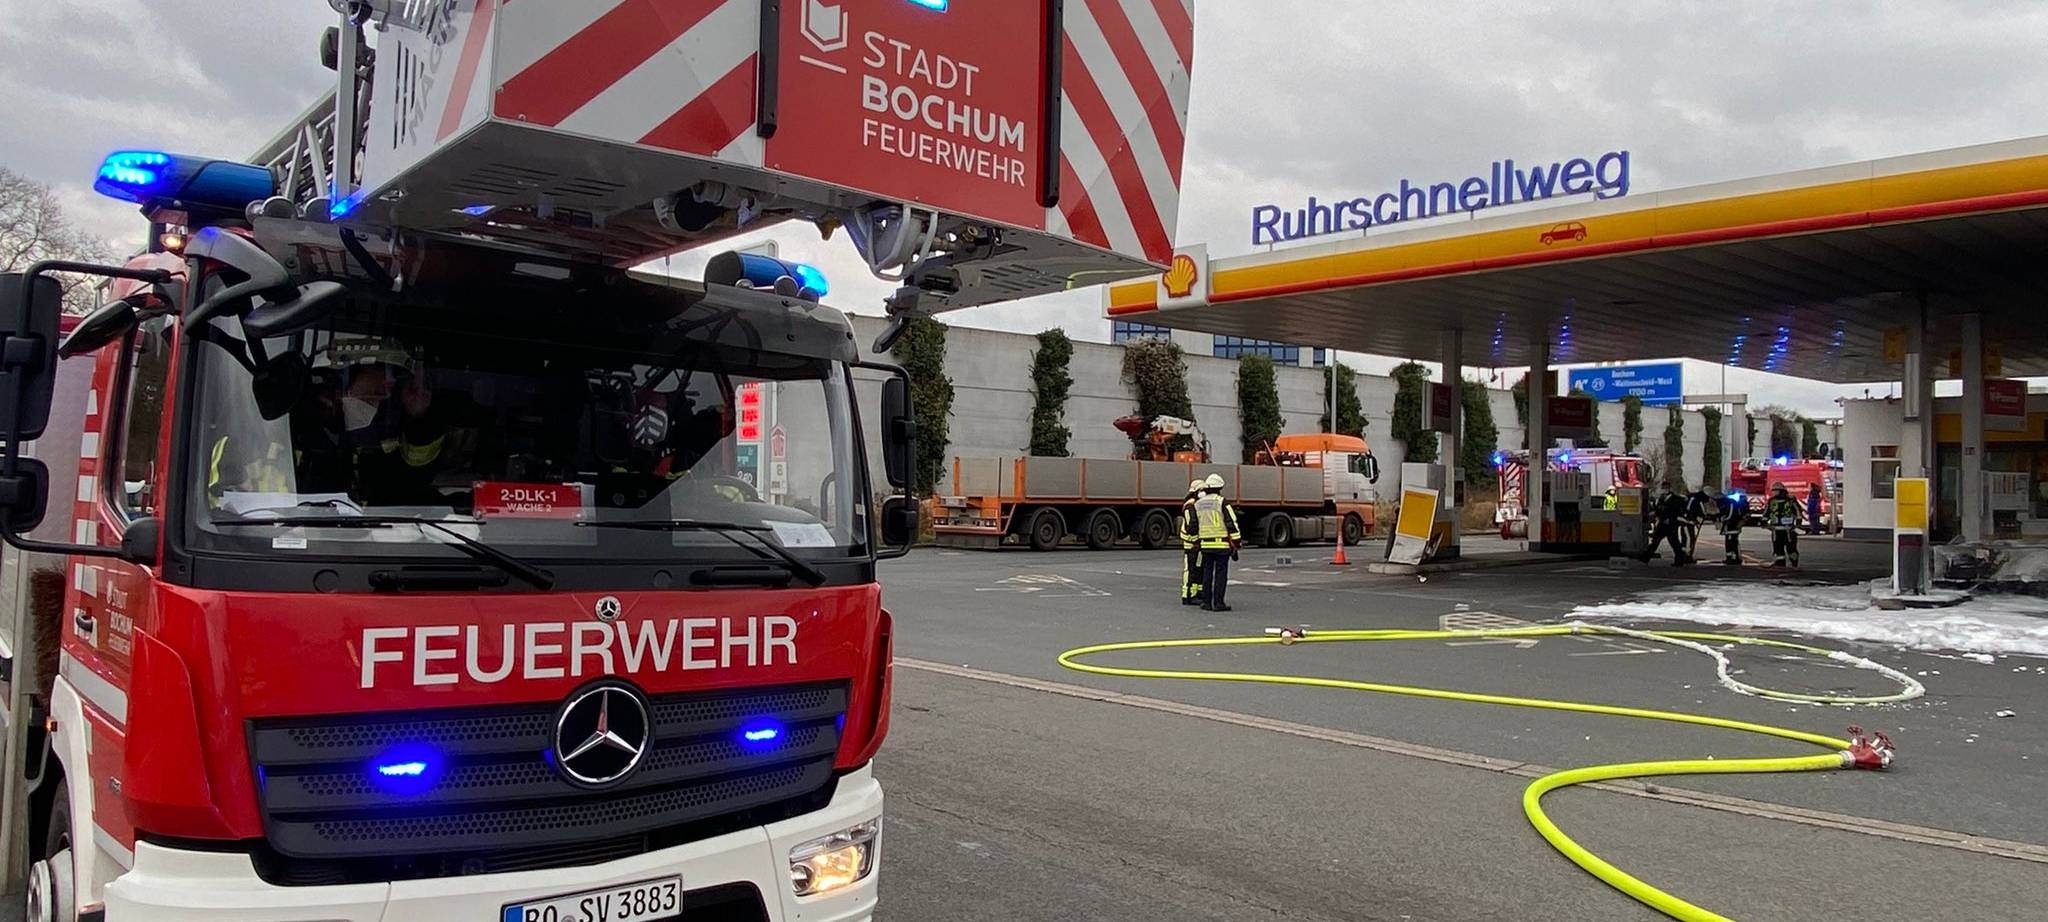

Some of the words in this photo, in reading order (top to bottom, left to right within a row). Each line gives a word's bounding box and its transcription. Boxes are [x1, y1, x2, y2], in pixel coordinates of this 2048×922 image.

[862, 31, 980, 97] STADT
[862, 74, 1025, 152] BOCHUM
[862, 118, 1025, 187] FEUERWEHR
[1252, 150, 1631, 246] Ruhrschnellweg
[500, 488, 557, 502] 2-DLK-1
[506, 502, 544, 512] WACHE
[545, 503, 552, 513] 2
[360, 615, 798, 689] FEUERWEHR
[580, 894, 610, 922] SV
[617, 883, 676, 919] 3883
